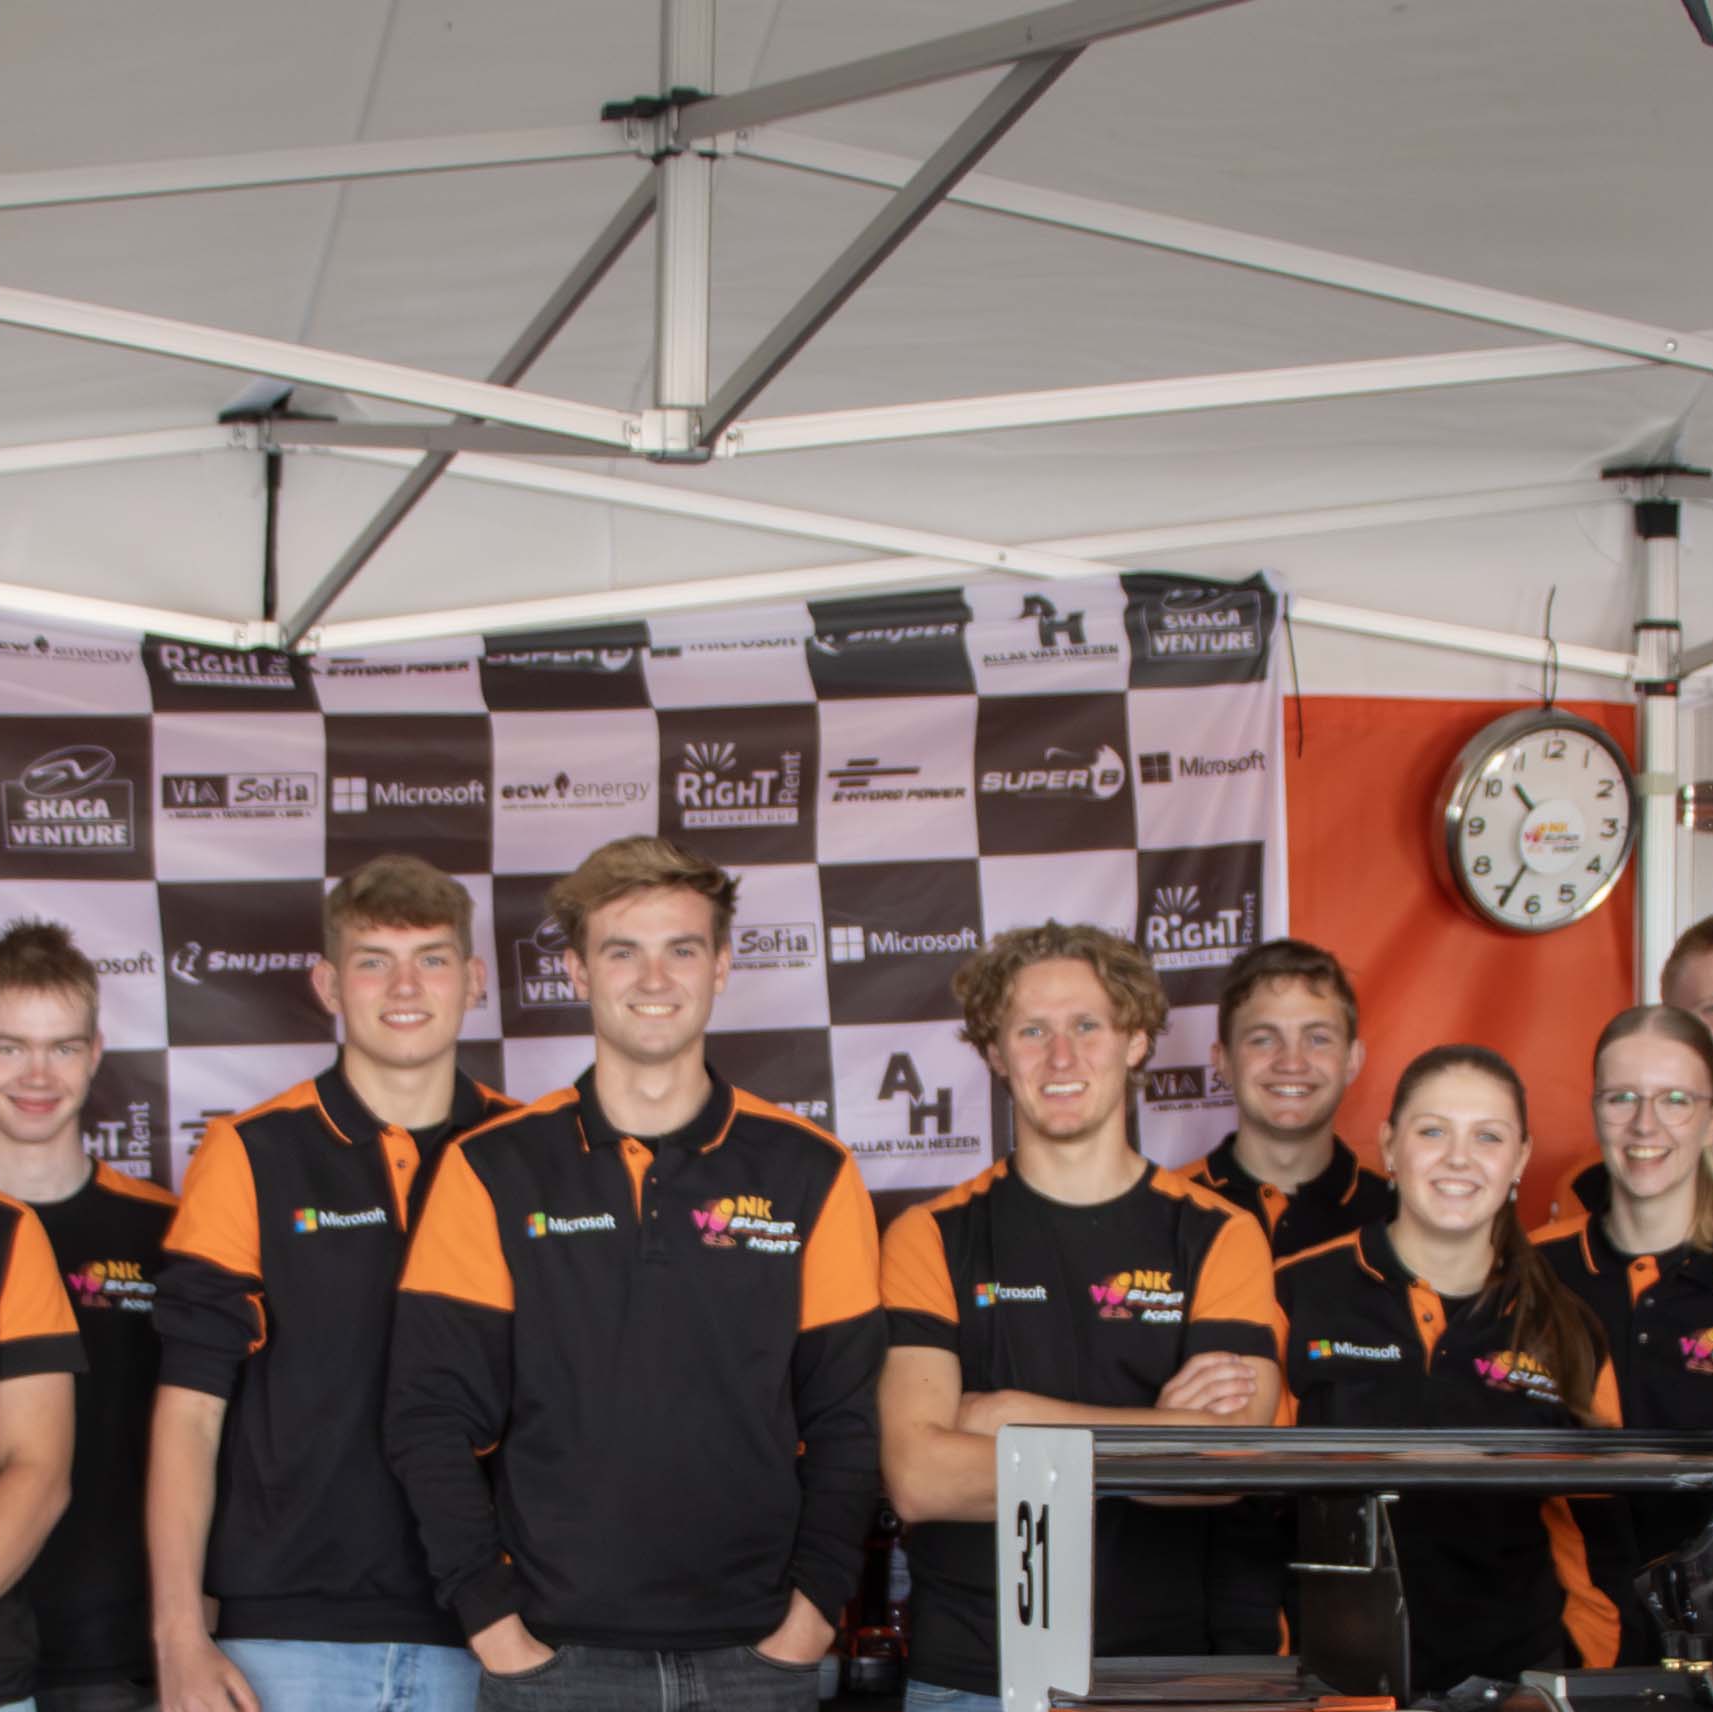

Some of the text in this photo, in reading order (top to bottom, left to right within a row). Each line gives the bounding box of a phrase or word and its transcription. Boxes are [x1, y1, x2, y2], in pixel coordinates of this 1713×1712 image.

[1163, 609, 1242, 630] SKAGA
[1153, 630, 1256, 654] VENTURE
[1544, 740, 1567, 759] 12
[1179, 751, 1267, 776] Microsoft
[778, 752, 801, 804] Rent
[981, 770, 1088, 793] SUPER
[1485, 779, 1503, 798] 10
[374, 779, 486, 806] Microsoft
[501, 779, 652, 802] ecw energy
[905, 787, 967, 800] POWER
[1596, 780, 1615, 798] 2
[24, 799, 112, 820] SKAGA
[10, 824, 129, 847] VENTURE
[1468, 817, 1485, 837] 9
[1600, 818, 1618, 838] 3
[1473, 856, 1492, 875] 8
[1586, 855, 1601, 874] 4
[1558, 884, 1576, 903] 5
[1524, 895, 1540, 914] 6
[737, 929, 810, 955] Sofia
[870, 928, 979, 954] Microsoft
[95, 952, 157, 975] osoft
[207, 950, 324, 974] SNIJDER
[127, 1101, 150, 1157] Rent
[896, 1138, 926, 1152] VAN
[928, 1135, 981, 1150] HEEZEN
[319, 1207, 387, 1228] Microsoft
[548, 1213, 616, 1232] Microsoft
[1333, 1341, 1401, 1360] Microsoft
[1017, 1500, 1049, 1629] 31
